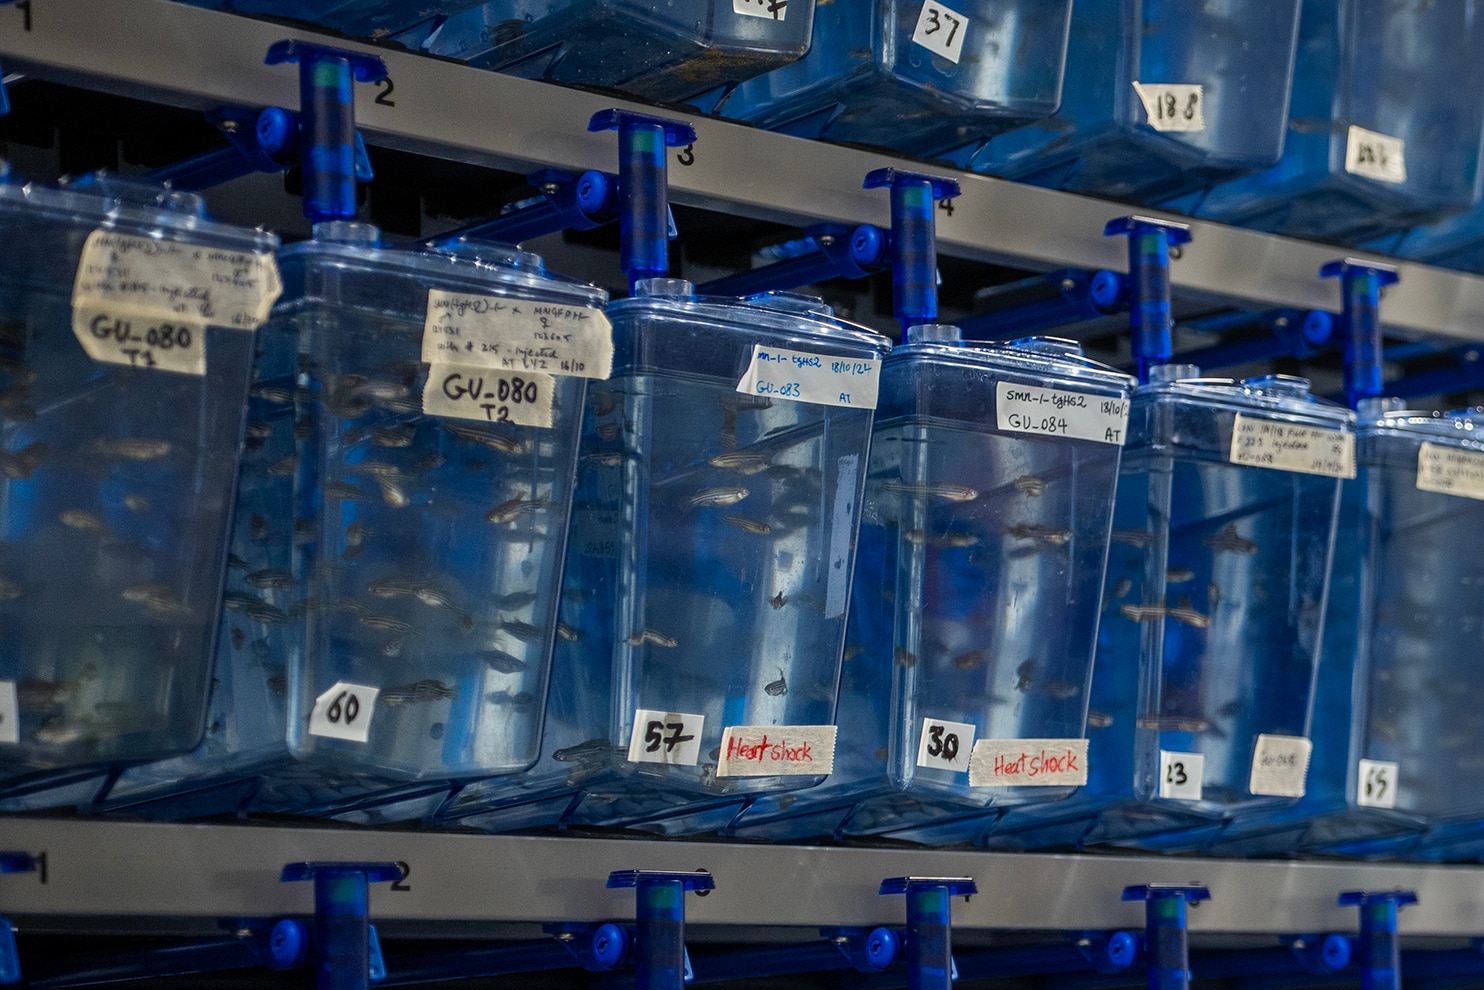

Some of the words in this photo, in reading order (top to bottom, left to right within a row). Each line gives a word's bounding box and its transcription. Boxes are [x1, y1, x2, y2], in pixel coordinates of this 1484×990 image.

[924, 8, 960, 48] 37
[374, 77, 395, 107] 2
[677, 143, 695, 166] 3
[938, 198, 954, 217] 4
[839, 392, 851, 404] AT
[480, 404, 515, 424] T2
[1104, 427, 1121, 442] AT
[326, 690, 360, 726] 60
[644, 720, 695, 753] 57
[927, 725, 959, 763] 30
[34, 851, 48, 884] 1
[390, 861, 411, 892] 2
